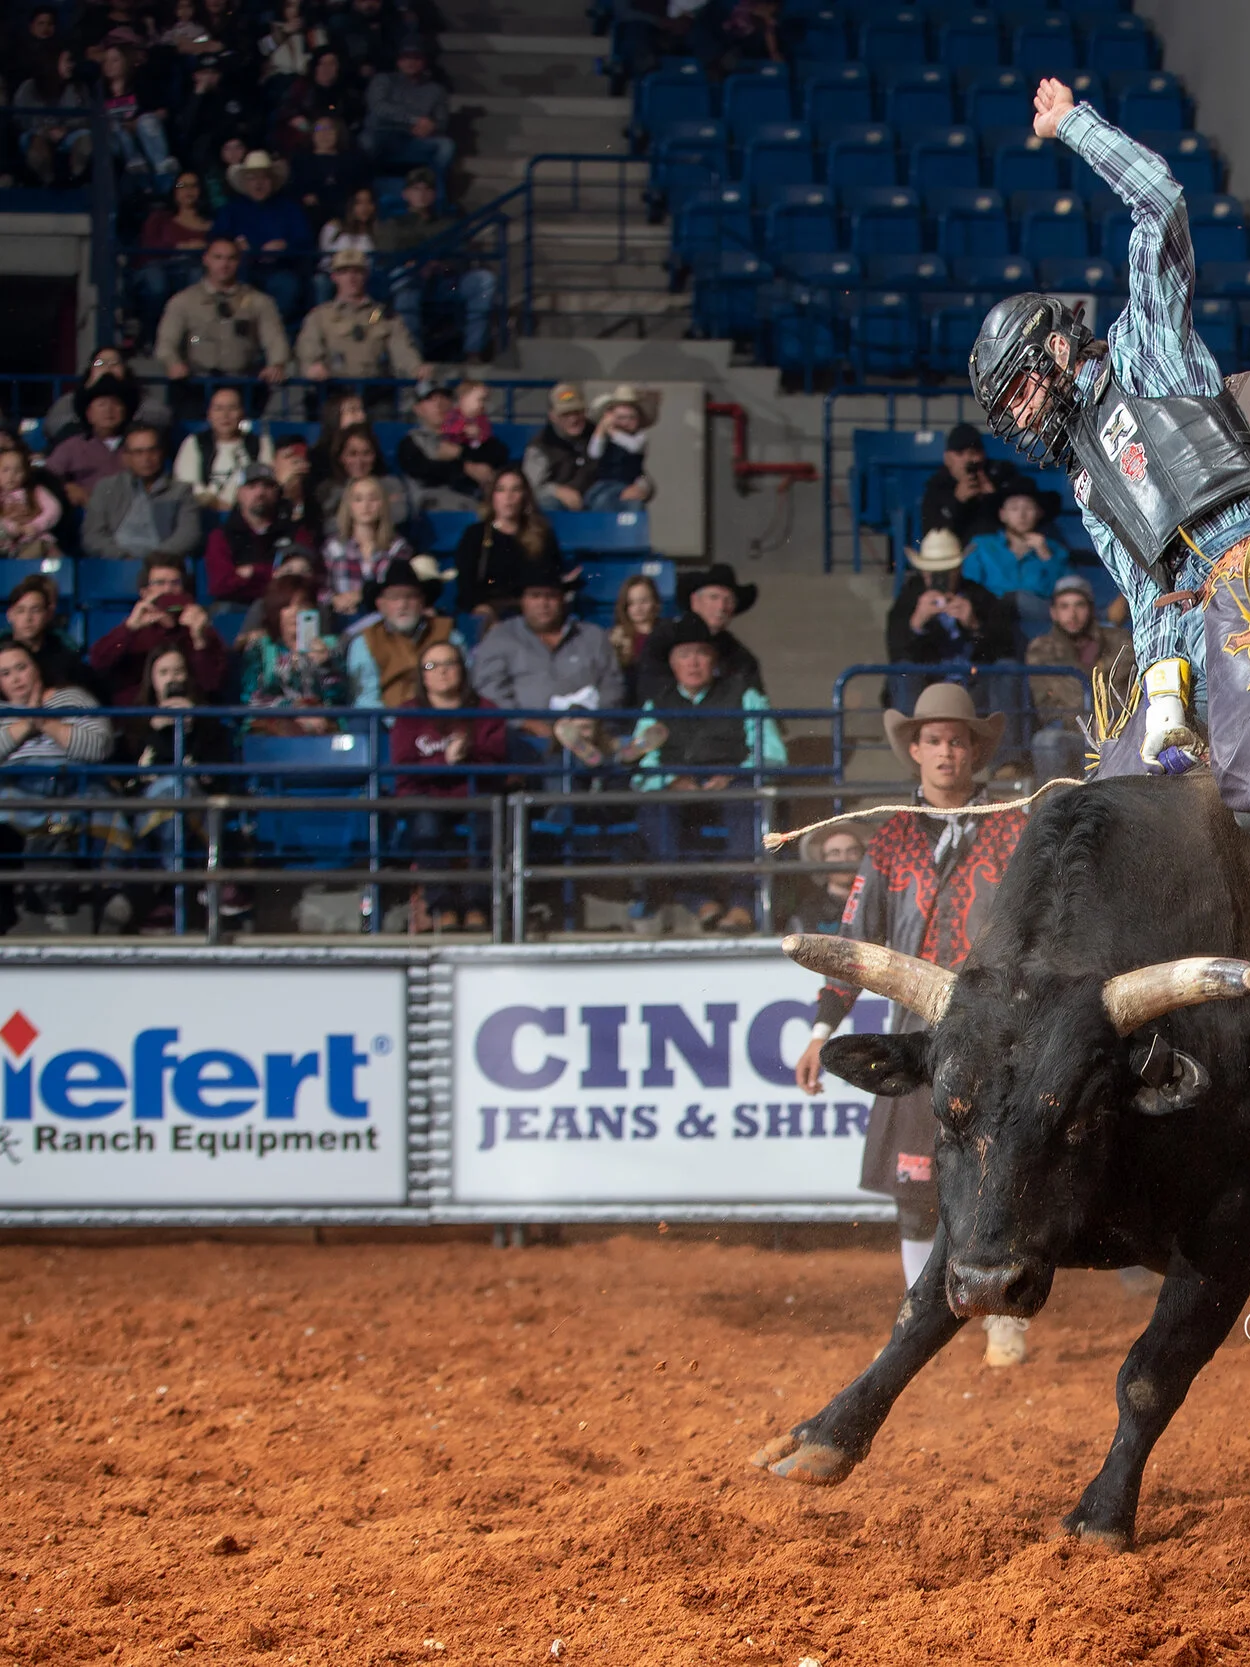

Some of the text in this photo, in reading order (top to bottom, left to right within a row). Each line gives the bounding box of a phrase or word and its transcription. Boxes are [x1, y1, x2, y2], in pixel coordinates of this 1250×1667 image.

[34, 1125, 155, 1153] Ranch
[171, 1125, 379, 1160] Equipment
[478, 1103, 658, 1150] JEANS
[676, 1101, 717, 1140] &
